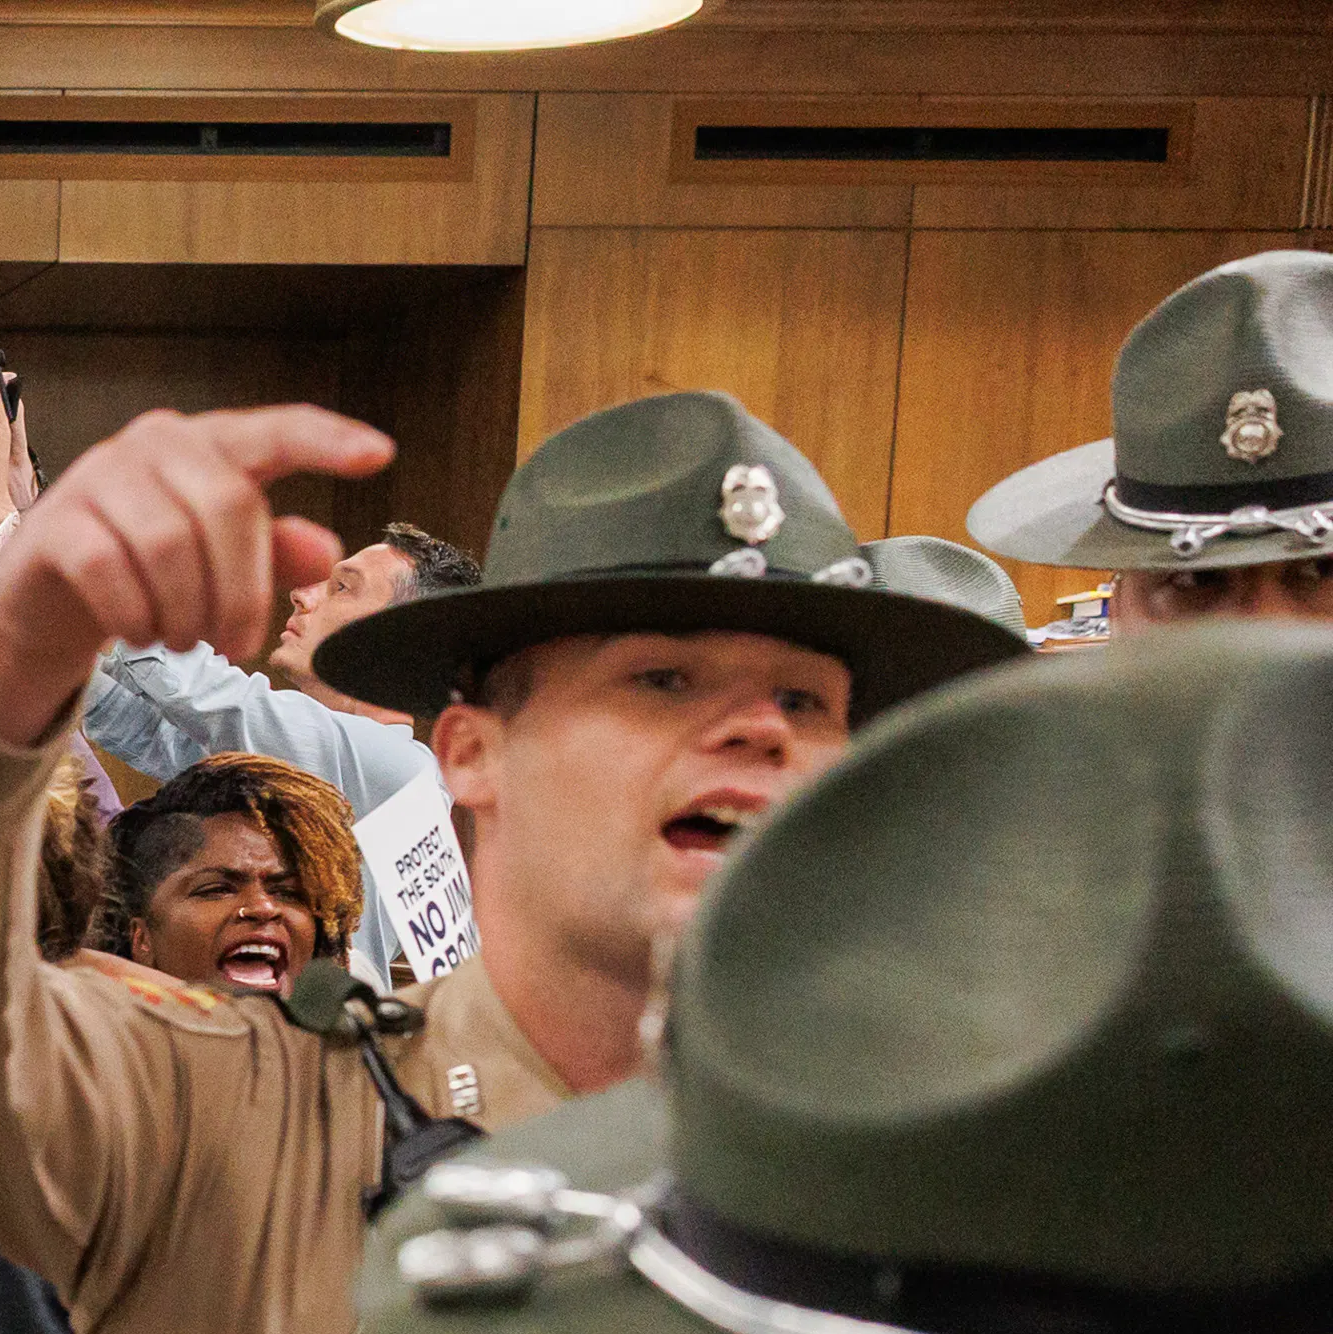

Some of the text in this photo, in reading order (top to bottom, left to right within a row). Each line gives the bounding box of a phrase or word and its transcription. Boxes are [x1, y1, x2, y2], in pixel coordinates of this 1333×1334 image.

[395, 825, 445, 882] PROTECT
[397, 877, 426, 910] THE
[408, 901, 446, 957] NO
